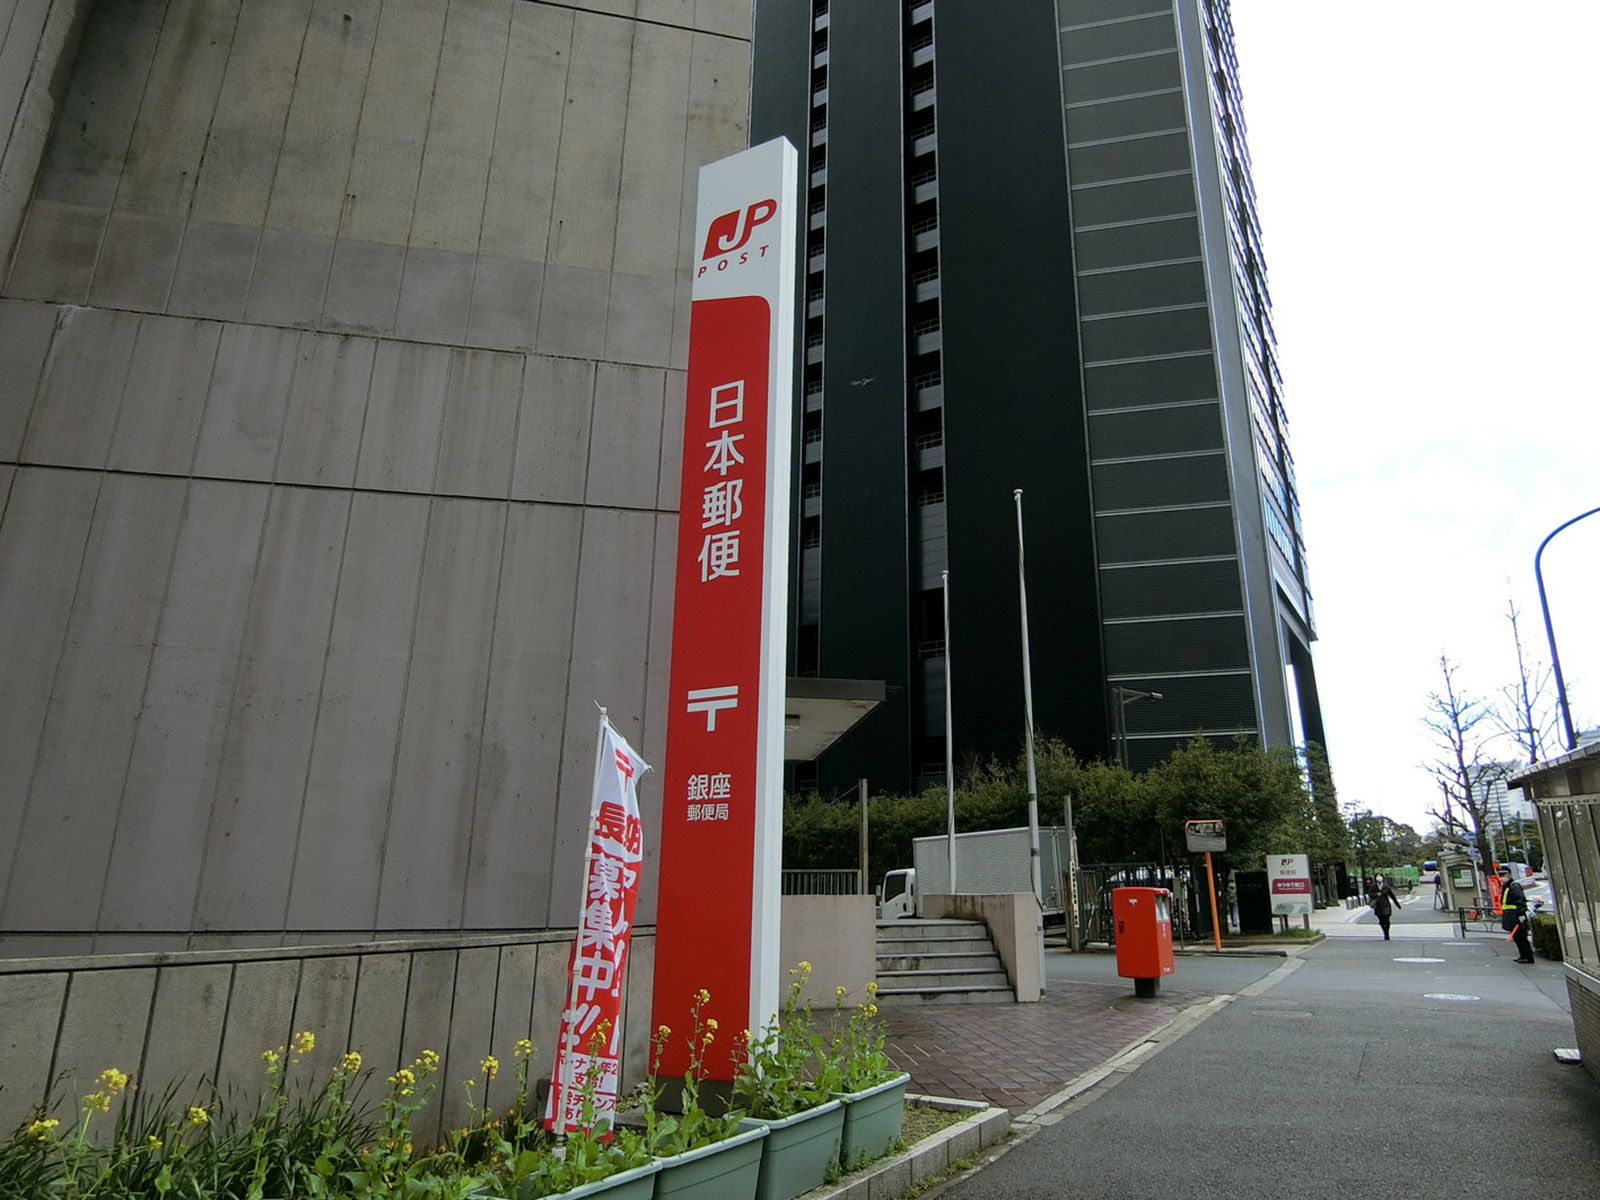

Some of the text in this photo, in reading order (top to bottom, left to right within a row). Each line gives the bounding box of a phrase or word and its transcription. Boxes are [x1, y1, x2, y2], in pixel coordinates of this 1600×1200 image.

[702, 199, 777, 261] JP
[698, 245, 769, 278] POST
[698, 379, 745, 583] 日本郵便
[687, 772, 731, 801] 銀座
[686, 803, 729, 822] 郵便局
